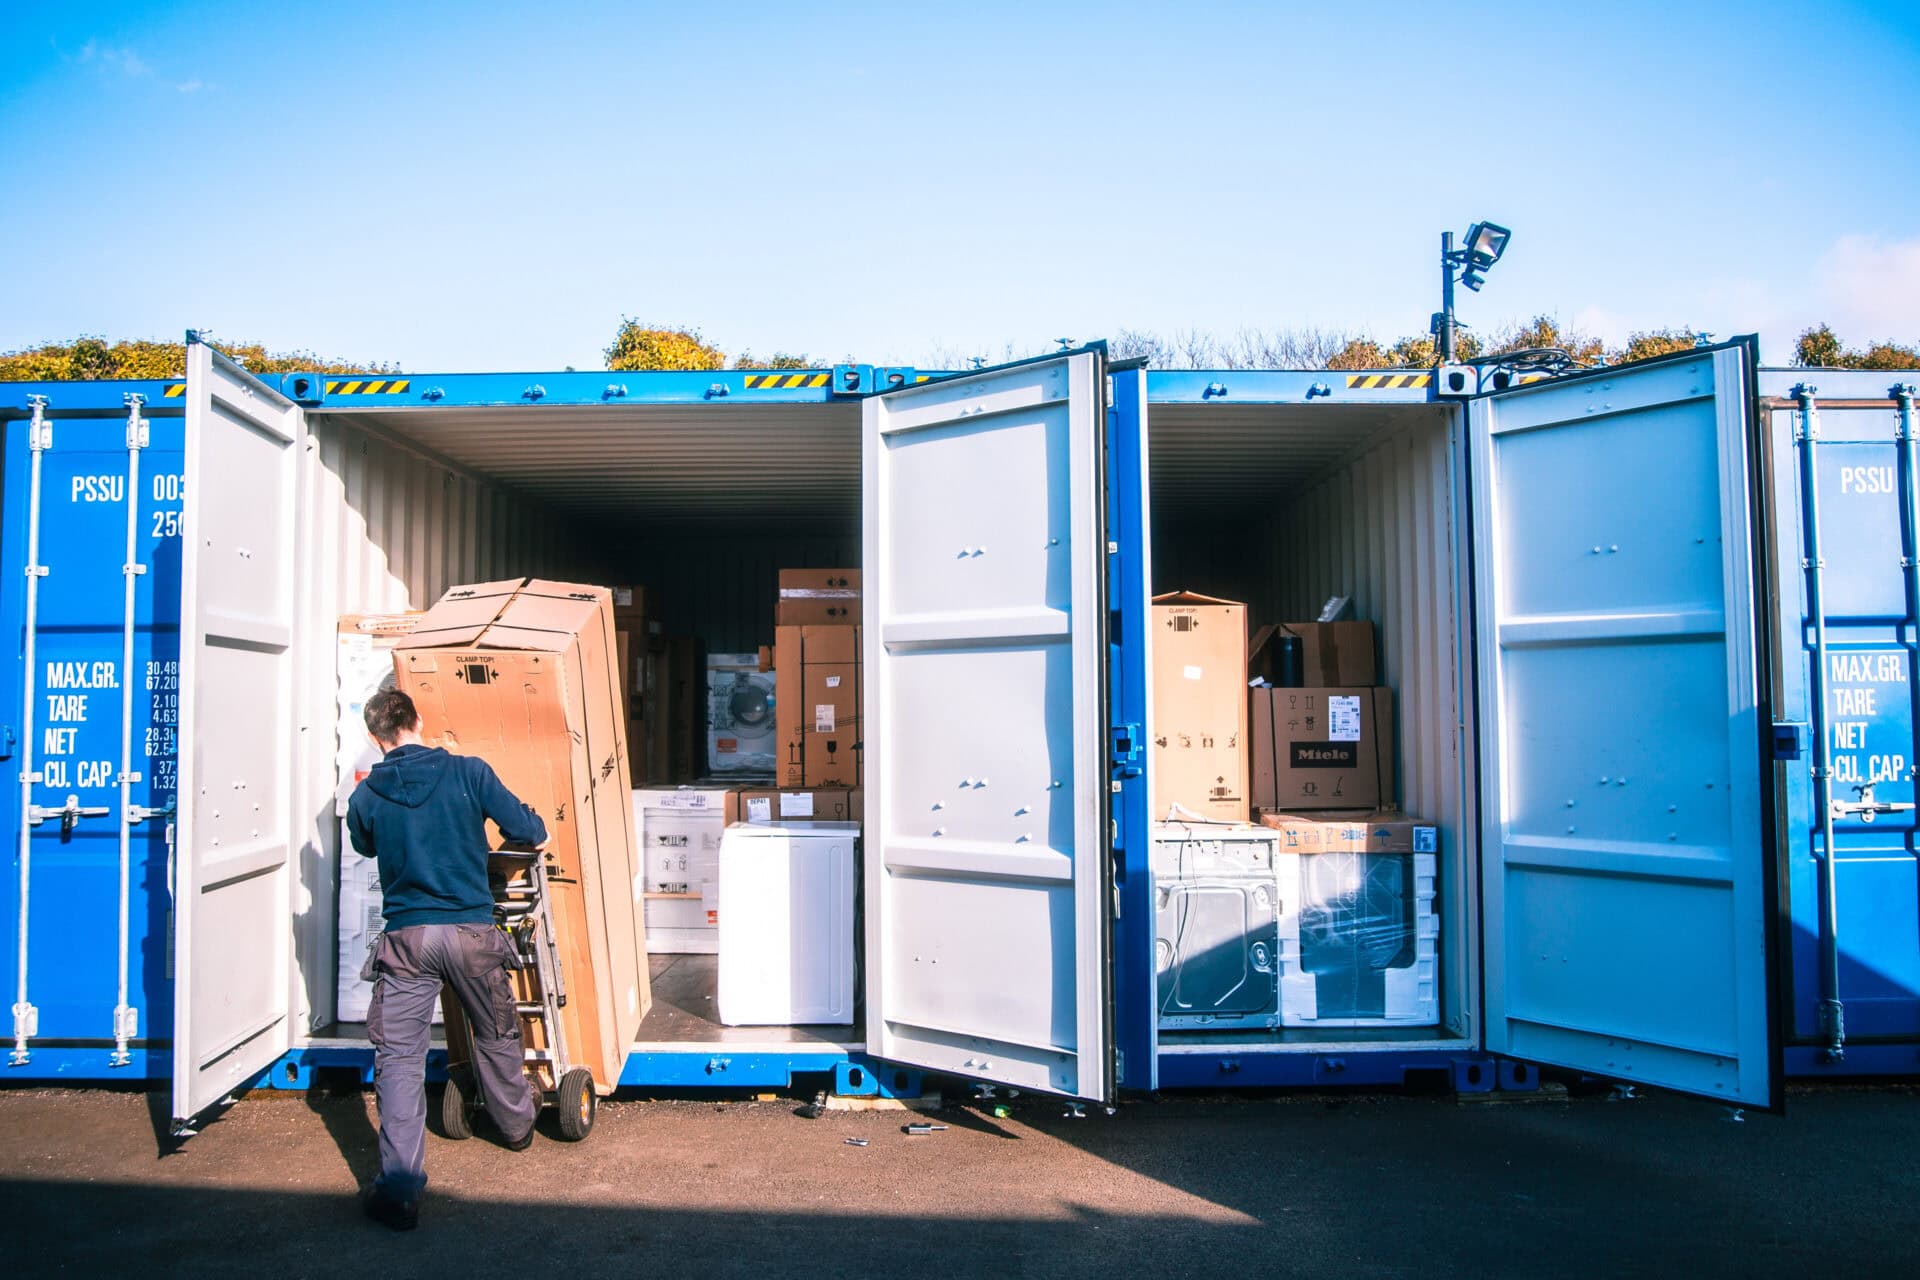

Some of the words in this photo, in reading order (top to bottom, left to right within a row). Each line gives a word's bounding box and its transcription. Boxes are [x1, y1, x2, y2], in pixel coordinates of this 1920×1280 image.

[71, 475, 124, 502] PSSU
[1841, 466, 1893, 494] PSSU
[46, 661, 120, 689] MAX.GR.
[1831, 655, 1907, 682] MAX.GR.
[46, 694, 88, 722] TARE
[1833, 688, 1877, 716] TARE
[44, 727, 78, 755] NET
[1834, 722, 1868, 749] NET
[1298, 749, 1349, 760] Miele
[1834, 755, 1863, 783] CU.
[1869, 754, 1911, 783] CAP.
[44, 760, 72, 788] CU.
[77, 760, 118, 788] CAP.
